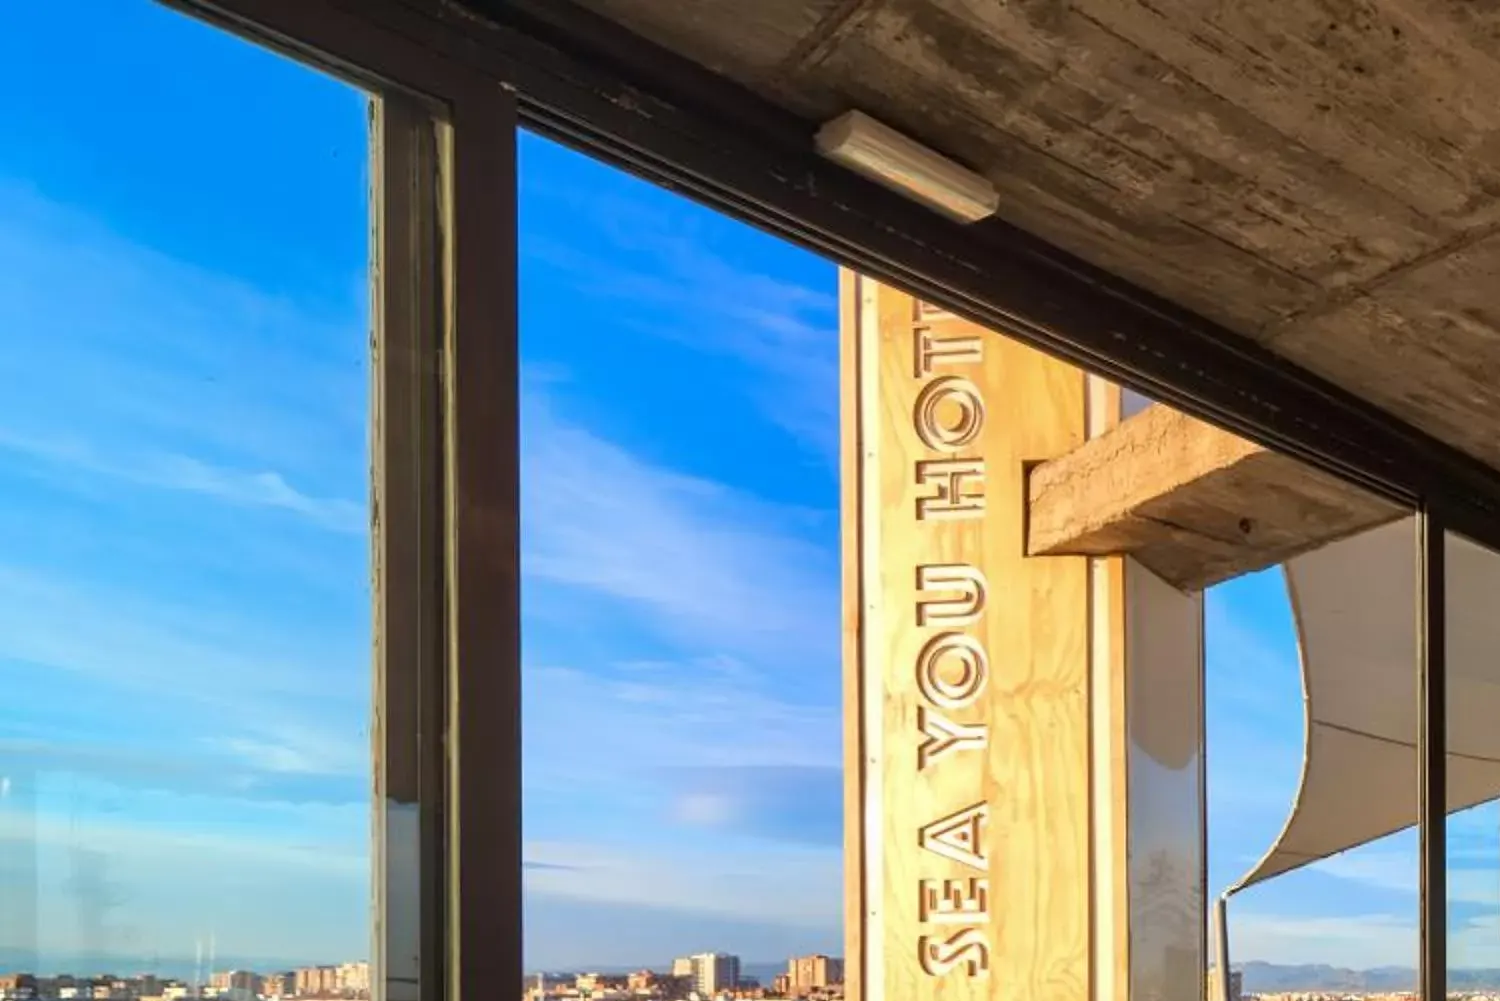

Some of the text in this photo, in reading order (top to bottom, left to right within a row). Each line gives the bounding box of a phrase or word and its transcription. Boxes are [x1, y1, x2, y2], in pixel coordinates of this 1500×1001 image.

[912, 296, 990, 977] SEA YOU HOT
